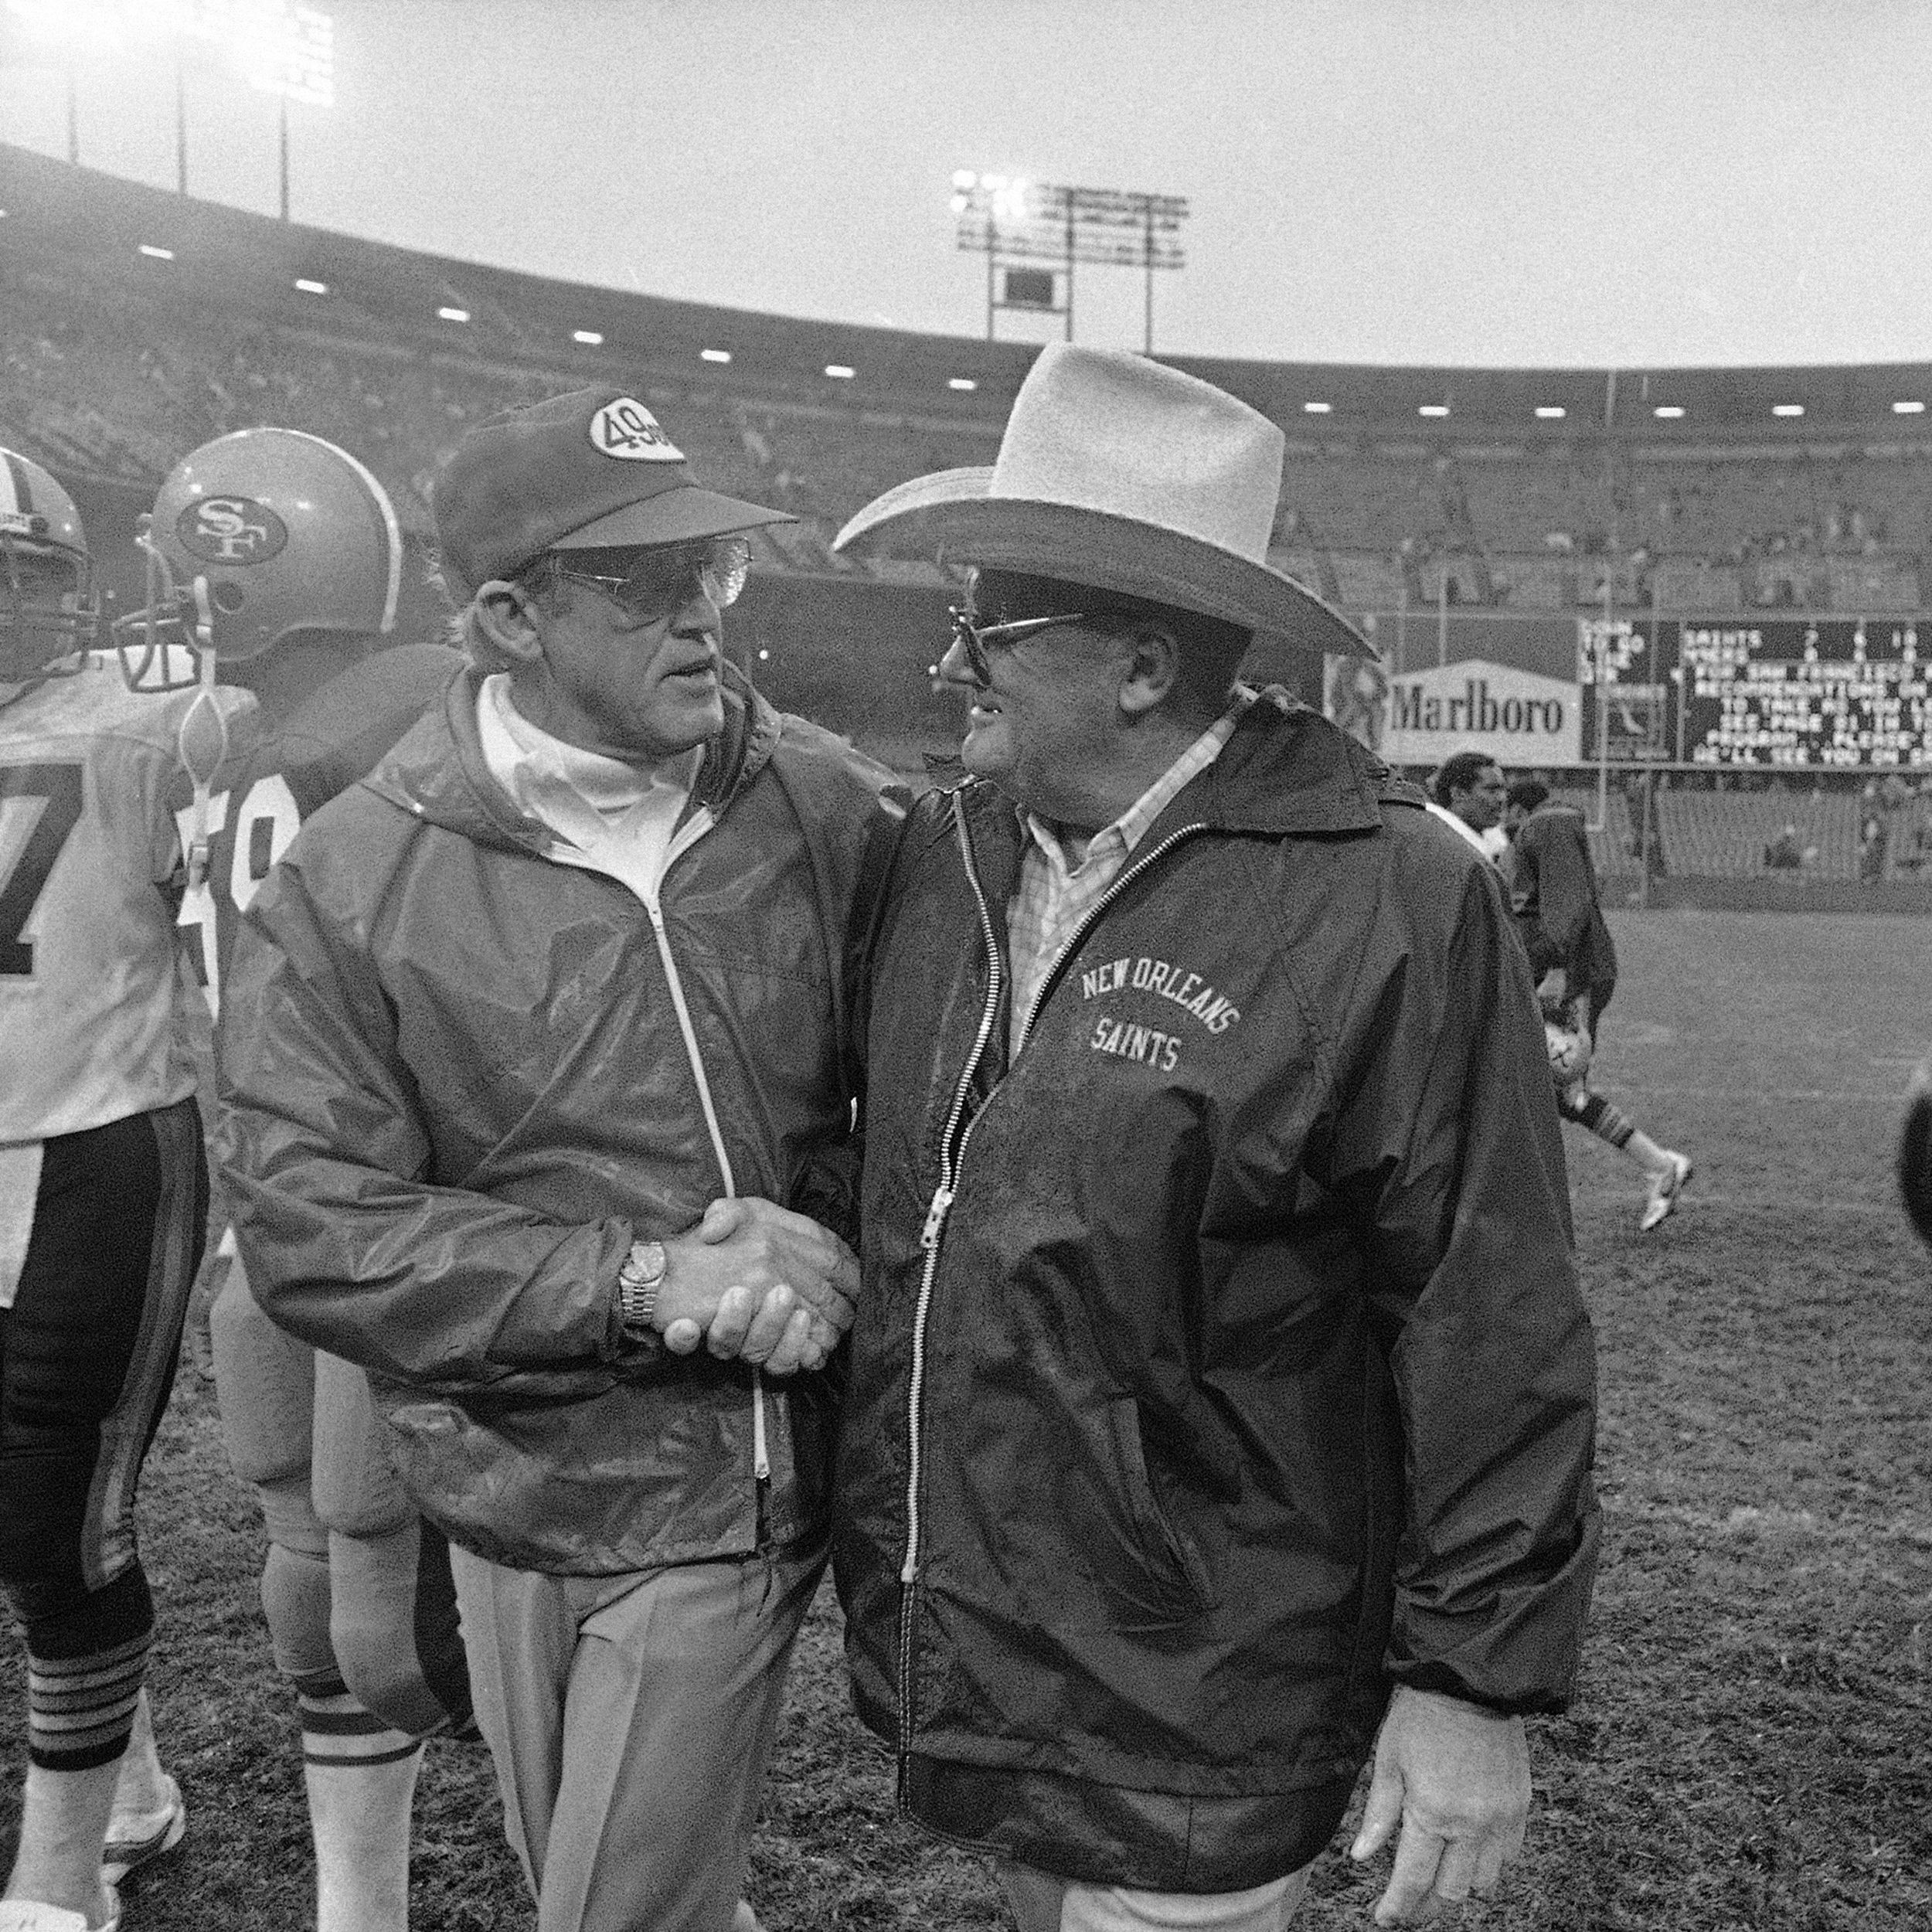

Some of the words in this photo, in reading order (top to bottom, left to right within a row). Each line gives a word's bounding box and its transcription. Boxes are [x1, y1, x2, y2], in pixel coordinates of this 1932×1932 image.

[197, 500, 267, 558] SF
[1390, 678, 1563, 733] Marlboro
[1082, 957, 1131, 1000] NEW
[1132, 957, 1240, 1035] ORLEANS
[1090, 1016, 1182, 1072] SAINTS
